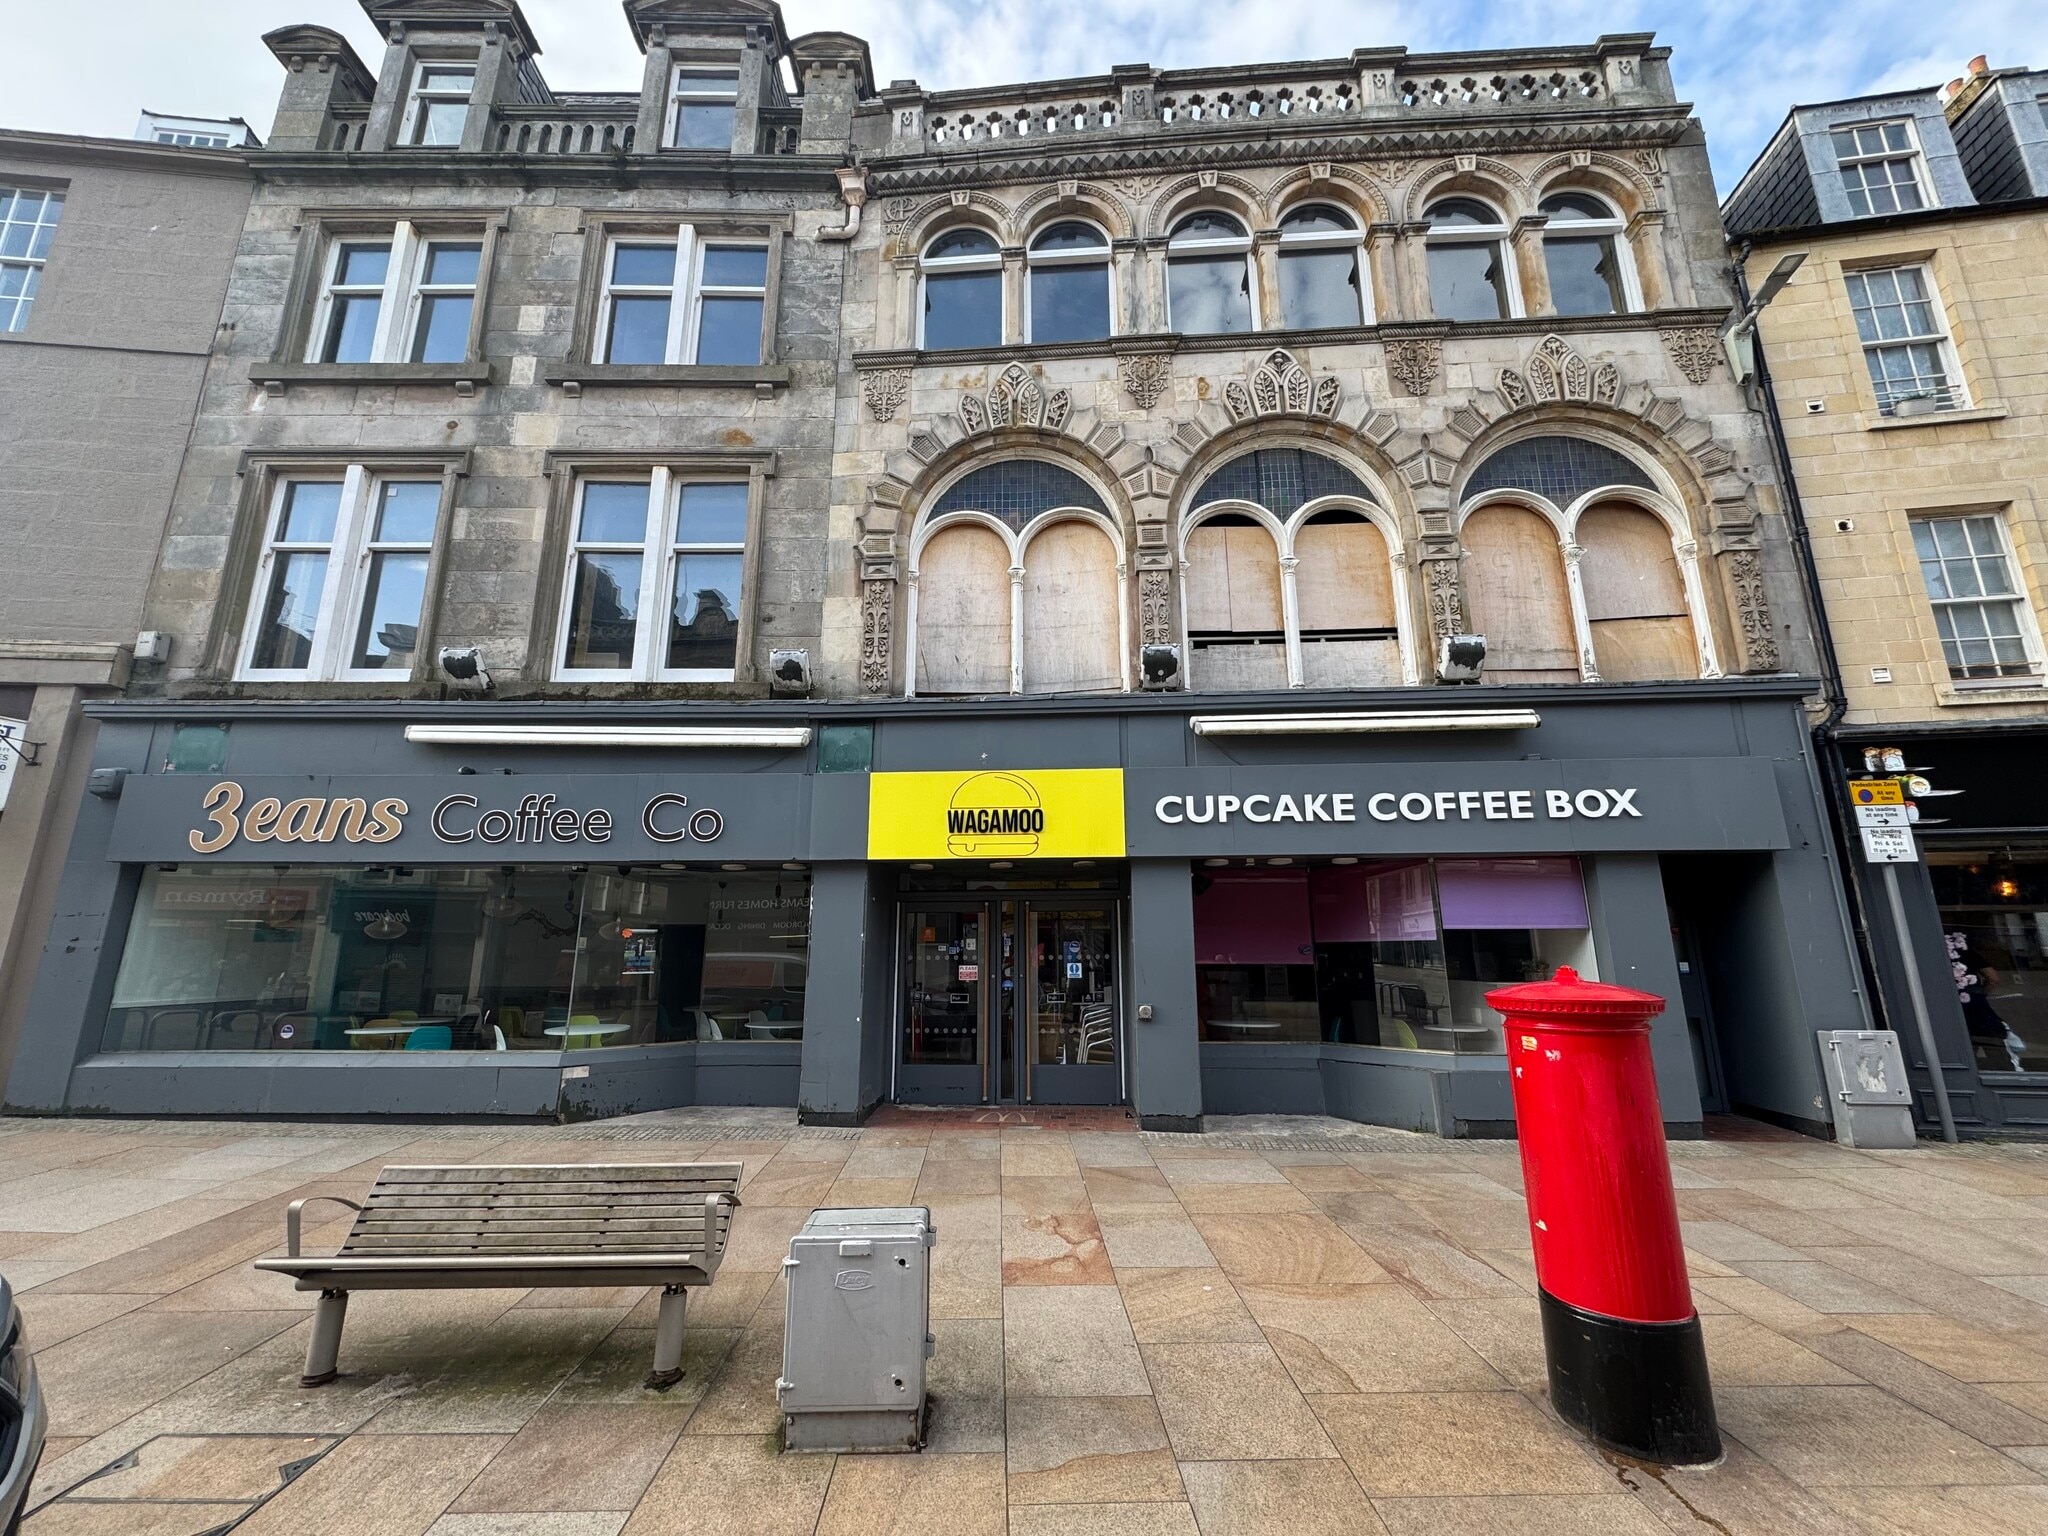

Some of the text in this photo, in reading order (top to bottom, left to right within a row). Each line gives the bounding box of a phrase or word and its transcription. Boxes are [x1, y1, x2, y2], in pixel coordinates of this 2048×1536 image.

[430, 793, 613, 843] Coffee
[641, 792, 724, 843] Co
[947, 808, 1044, 834] WAGAMOO
[1155, 788, 1643, 824] CUPCAKE COFFEE BOX
